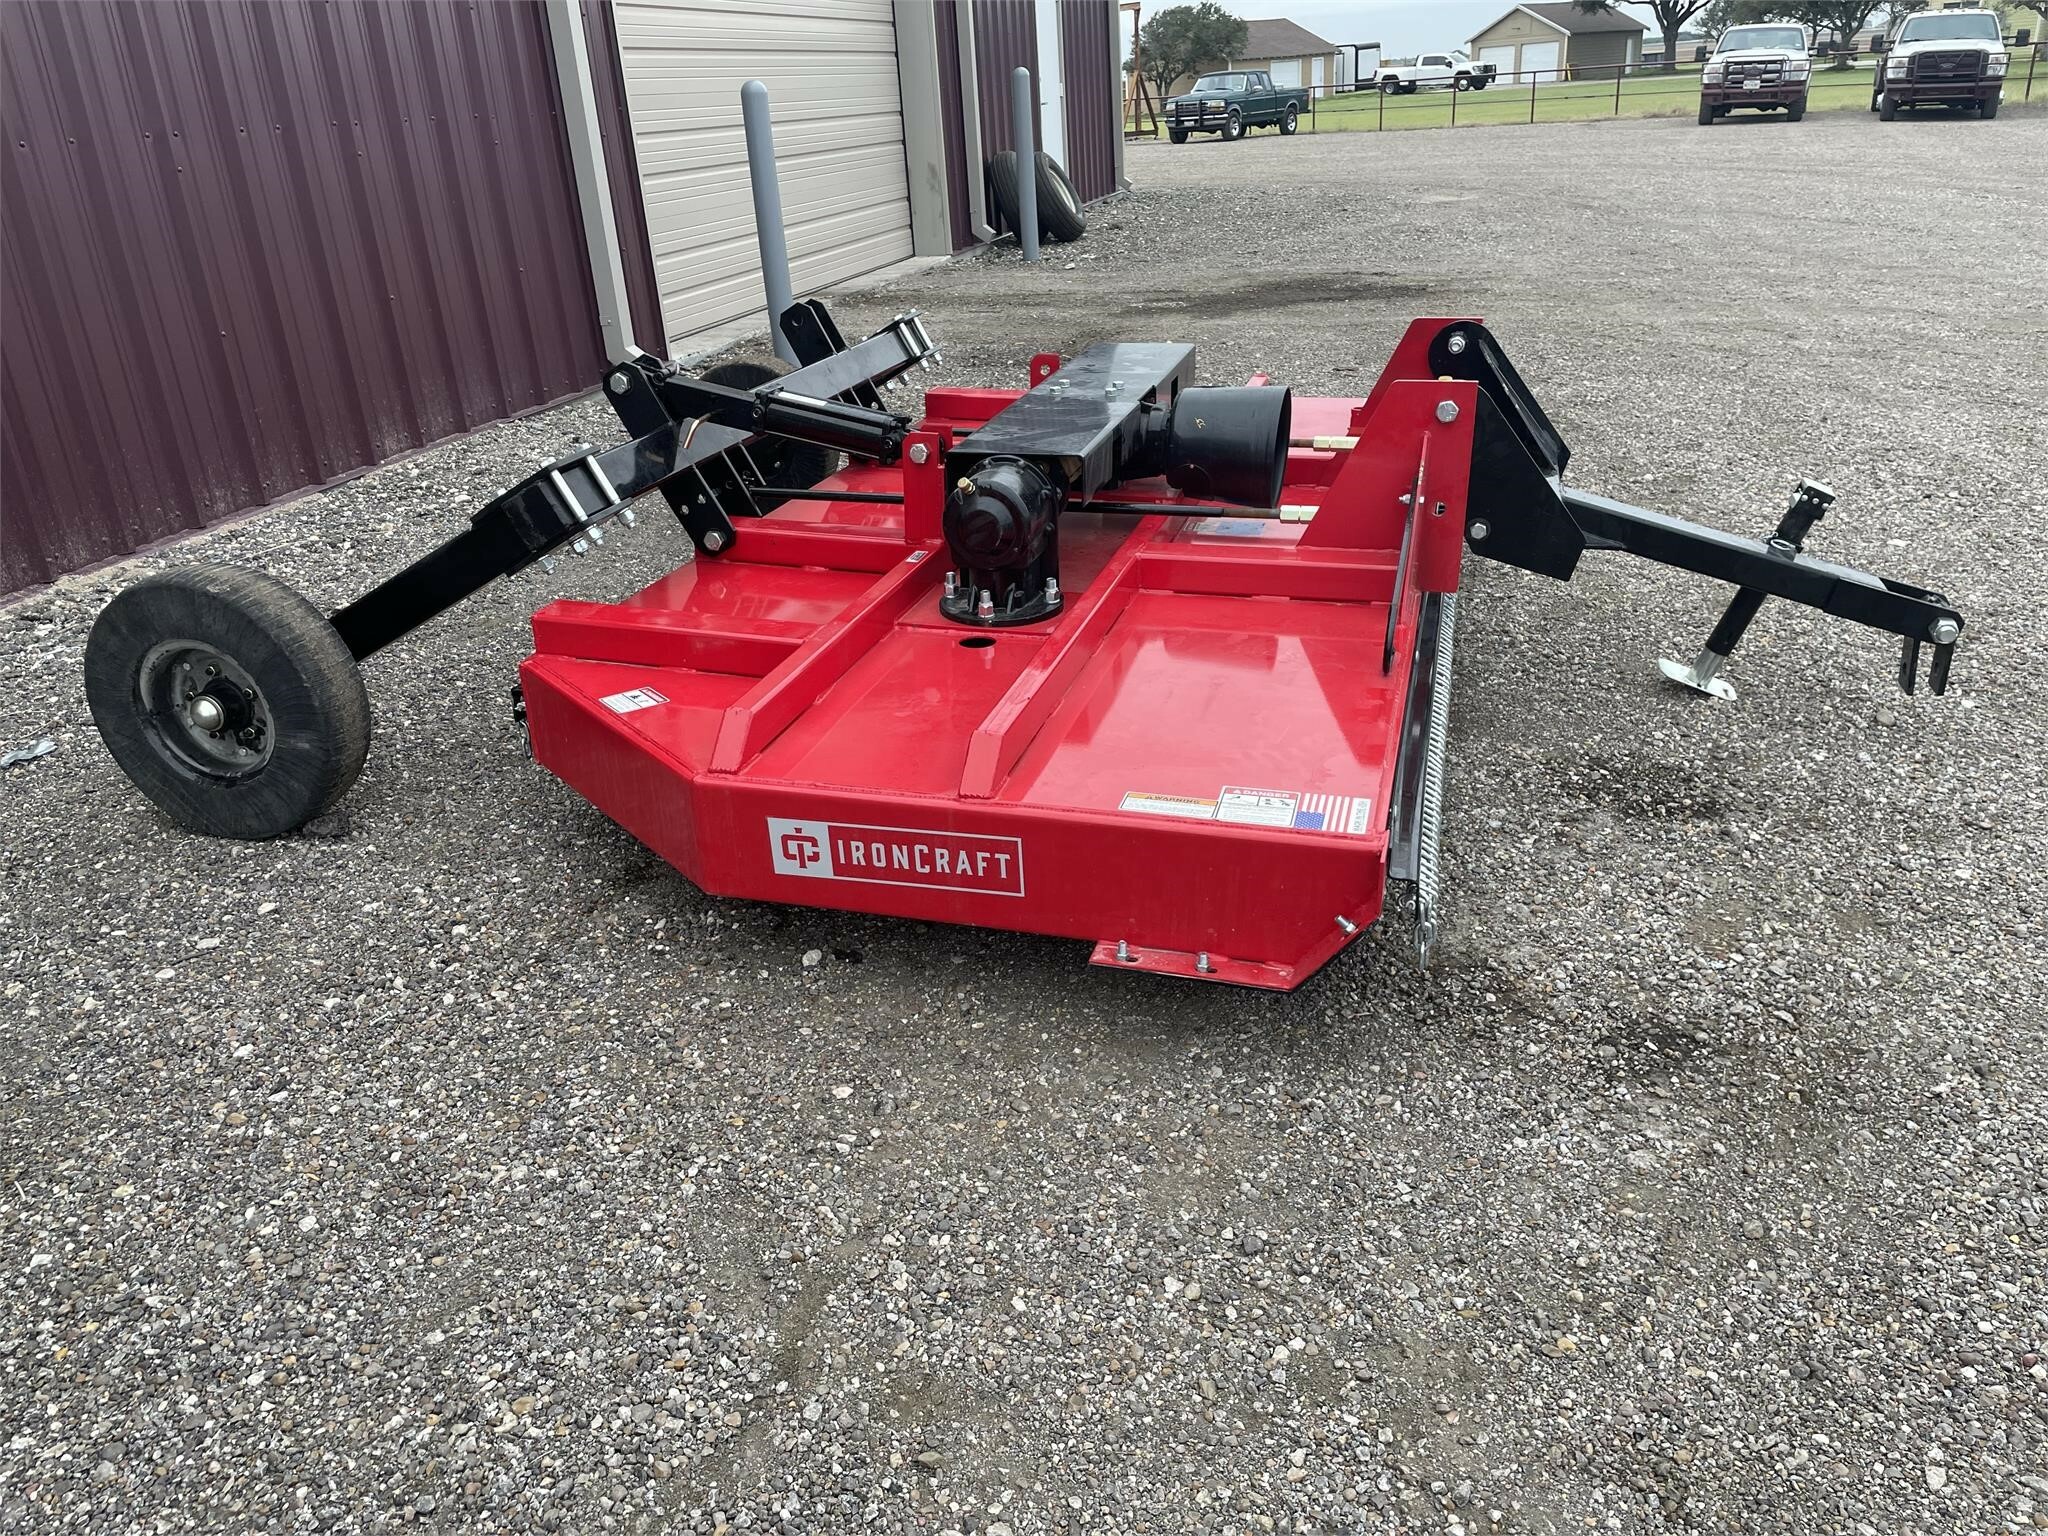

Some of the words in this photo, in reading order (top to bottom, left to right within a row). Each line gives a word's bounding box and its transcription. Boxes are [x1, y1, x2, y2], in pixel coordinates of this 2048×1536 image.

[1155, 794, 1201, 805] WARNING
[1243, 790, 1290, 799] DANGER
[838, 839, 1010, 878] IRONCRAFT
